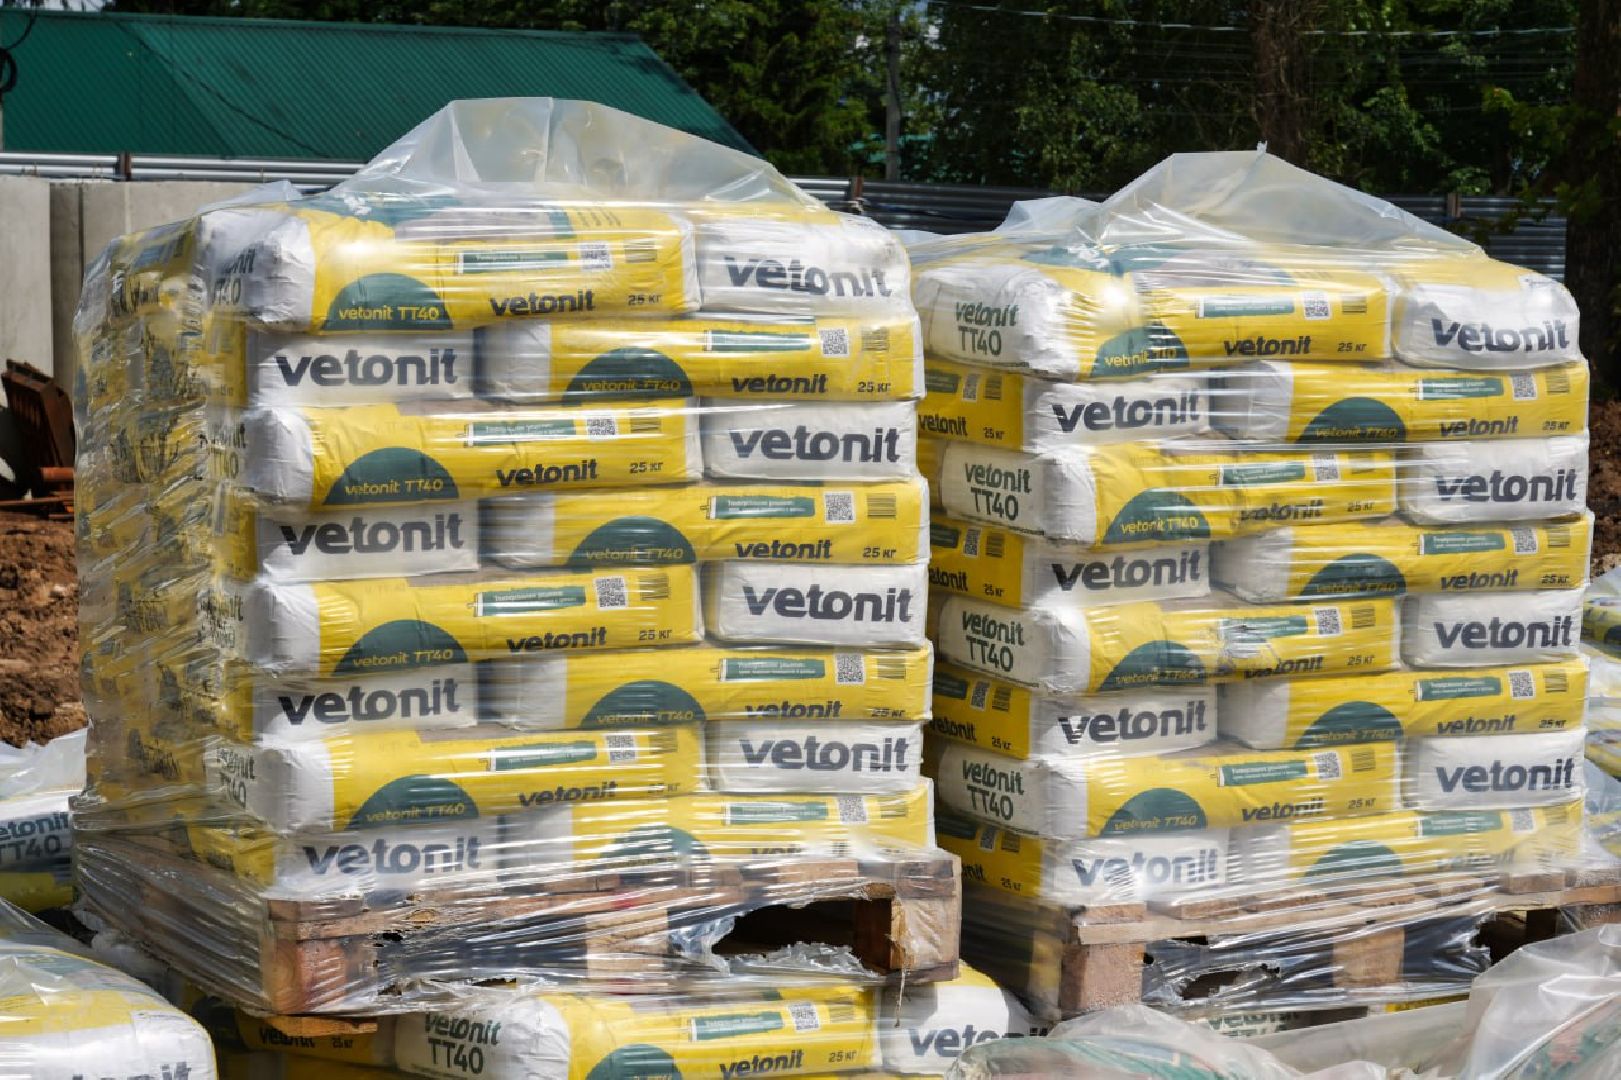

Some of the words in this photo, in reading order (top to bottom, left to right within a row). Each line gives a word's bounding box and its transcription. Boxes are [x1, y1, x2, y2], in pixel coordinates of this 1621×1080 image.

[724, 256, 892, 298] vetonit
[490, 289, 595, 316] vetonit
[628, 294, 645, 306] 25
[338, 305, 393, 322] vetonit
[399, 305, 440, 321] TT40
[955, 301, 1020, 327] vetonit
[958, 325, 1002, 356] TT40
[1224, 334, 1311, 357] vetonit
[1337, 342, 1353, 352] 25
[1431, 318, 1571, 353] vetonit
[274, 348, 459, 388] vetonit
[732, 373, 829, 394] vetonit
[857, 381, 874, 393] 25
[1051, 388, 1201, 433] vetonit
[918, 413, 969, 437] vetonit
[1439, 415, 1519, 437] vetonit
[1541, 420, 1558, 431] 25
[729, 425, 901, 463] vetonit
[496, 458, 598, 487] vetonit
[629, 462, 646, 474] 25
[964, 462, 1032, 493] vetonit
[345, 479, 400, 496] vetonit
[405, 478, 444, 492] TT40
[1436, 469, 1578, 502] vetonit
[970, 486, 1019, 520] TT40
[278, 513, 465, 555] vetonit
[735, 539, 833, 560] vetonit
[862, 546, 880, 559] 25
[1051, 551, 1201, 592] vetonit
[1440, 569, 1519, 591] vetonit
[1541, 574, 1557, 585] 25
[742, 583, 914, 622] vetonit
[506, 627, 607, 653] vetonit
[639, 629, 656, 641] 25
[961, 610, 1025, 646] vetonit
[1434, 615, 1573, 649] vetonit
[353, 653, 408, 667] vetonit
[412, 649, 454, 665] TT40
[965, 636, 1014, 672] TT40
[278, 678, 459, 726] vetonit
[745, 699, 843, 720] vetonit
[1058, 700, 1207, 745] vetonit
[1437, 714, 1517, 735] vetonit
[739, 735, 909, 772] vetonit
[962, 759, 1025, 796] vetonit
[1436, 757, 1575, 793] vetonit
[519, 781, 619, 807] vetonit
[966, 785, 1014, 821] TT40
[1348, 799, 1365, 810] 25
[366, 808, 422, 824] vetonit
[1164, 814, 1197, 827] TT40
[1241, 797, 1323, 822] vetonit
[302, 835, 482, 875] vetonit
[428, 1037, 484, 1075] TT40
[719, 1049, 805, 1080] vetonit
[828, 1051, 845, 1063] 25
